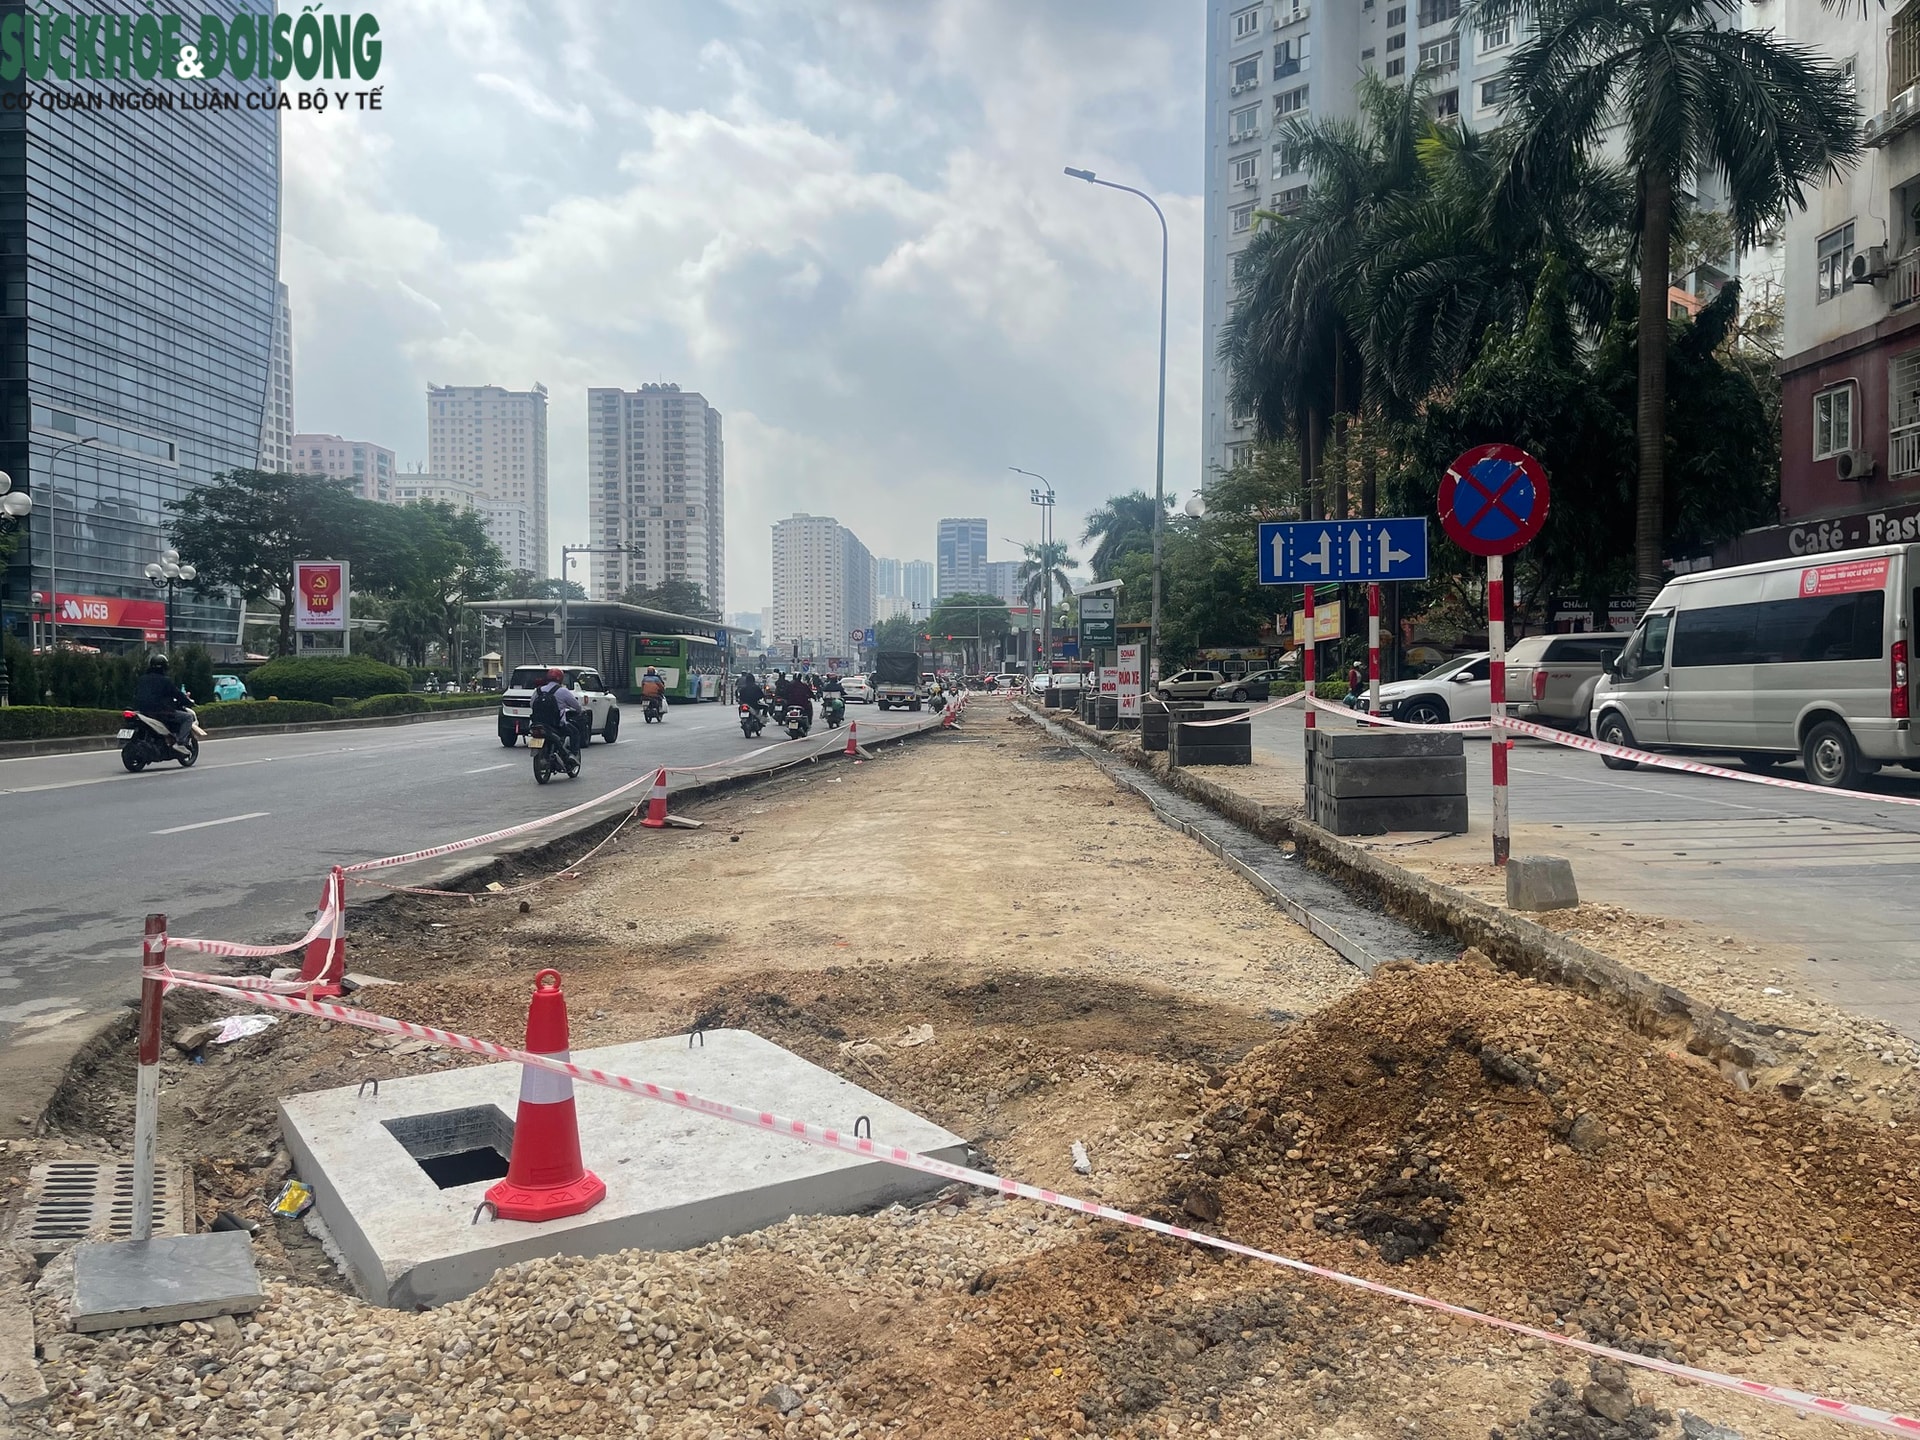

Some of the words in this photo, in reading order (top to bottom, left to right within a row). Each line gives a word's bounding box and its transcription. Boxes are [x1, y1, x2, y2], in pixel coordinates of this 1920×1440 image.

[1788, 520, 1844, 556] Café
[312, 598, 329, 606] XIV
[83, 603, 108, 620] MSB
